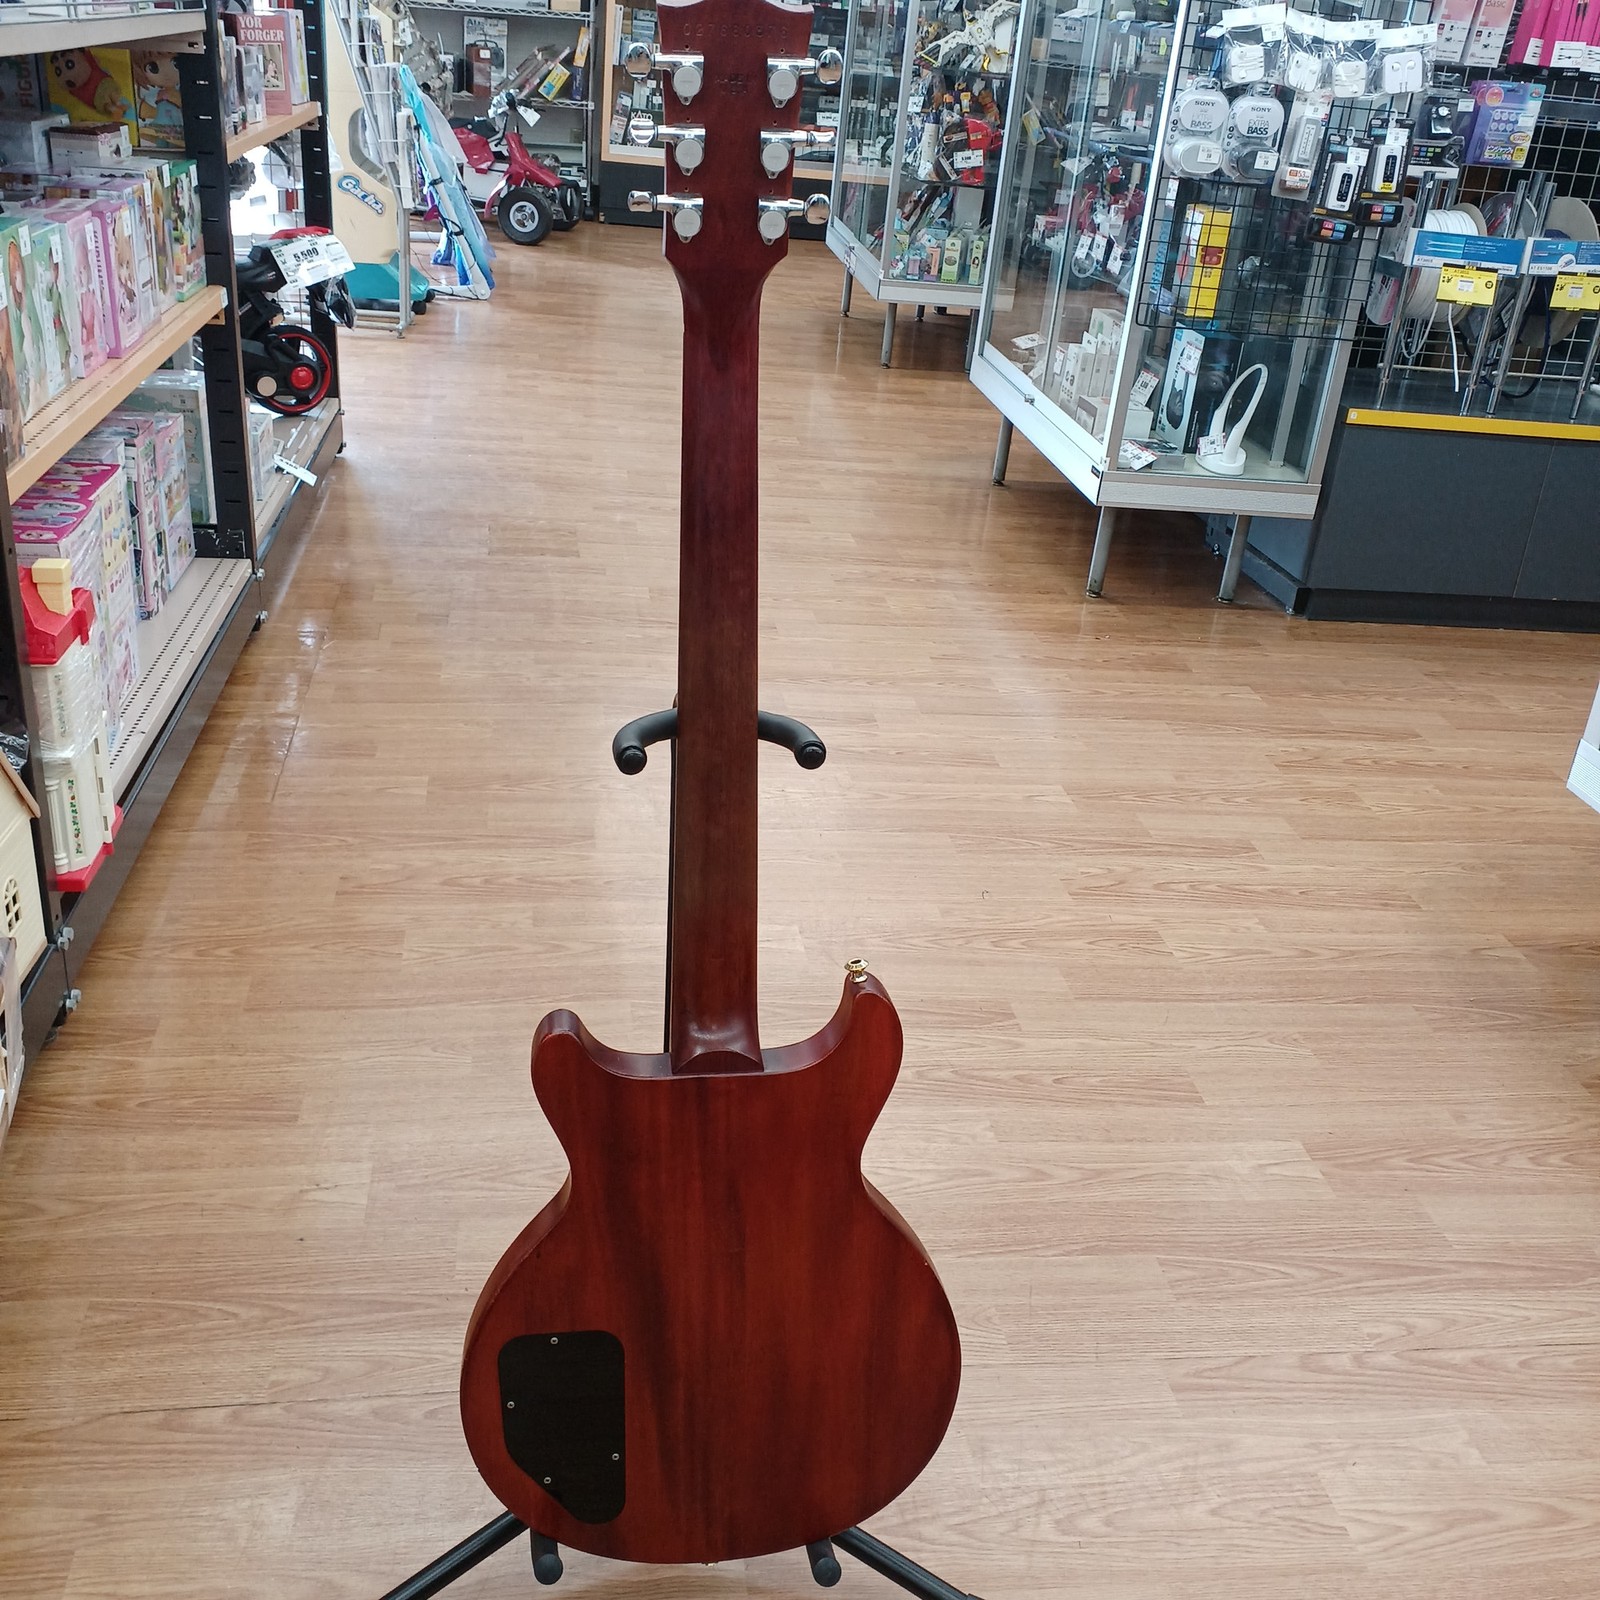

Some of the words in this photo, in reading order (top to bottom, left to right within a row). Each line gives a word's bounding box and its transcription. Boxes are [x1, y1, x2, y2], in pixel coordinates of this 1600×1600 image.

[238, 16, 262, 29] YOR
[240, 29, 285, 41] FORGER
[630, 110, 653, 121] KATO
[1190, 120, 1213, 129] BASS
[1248, 119, 1270, 128] EXTRA
[1246, 126, 1269, 136] BASS
[293, 247, 319, 262] 5,500
